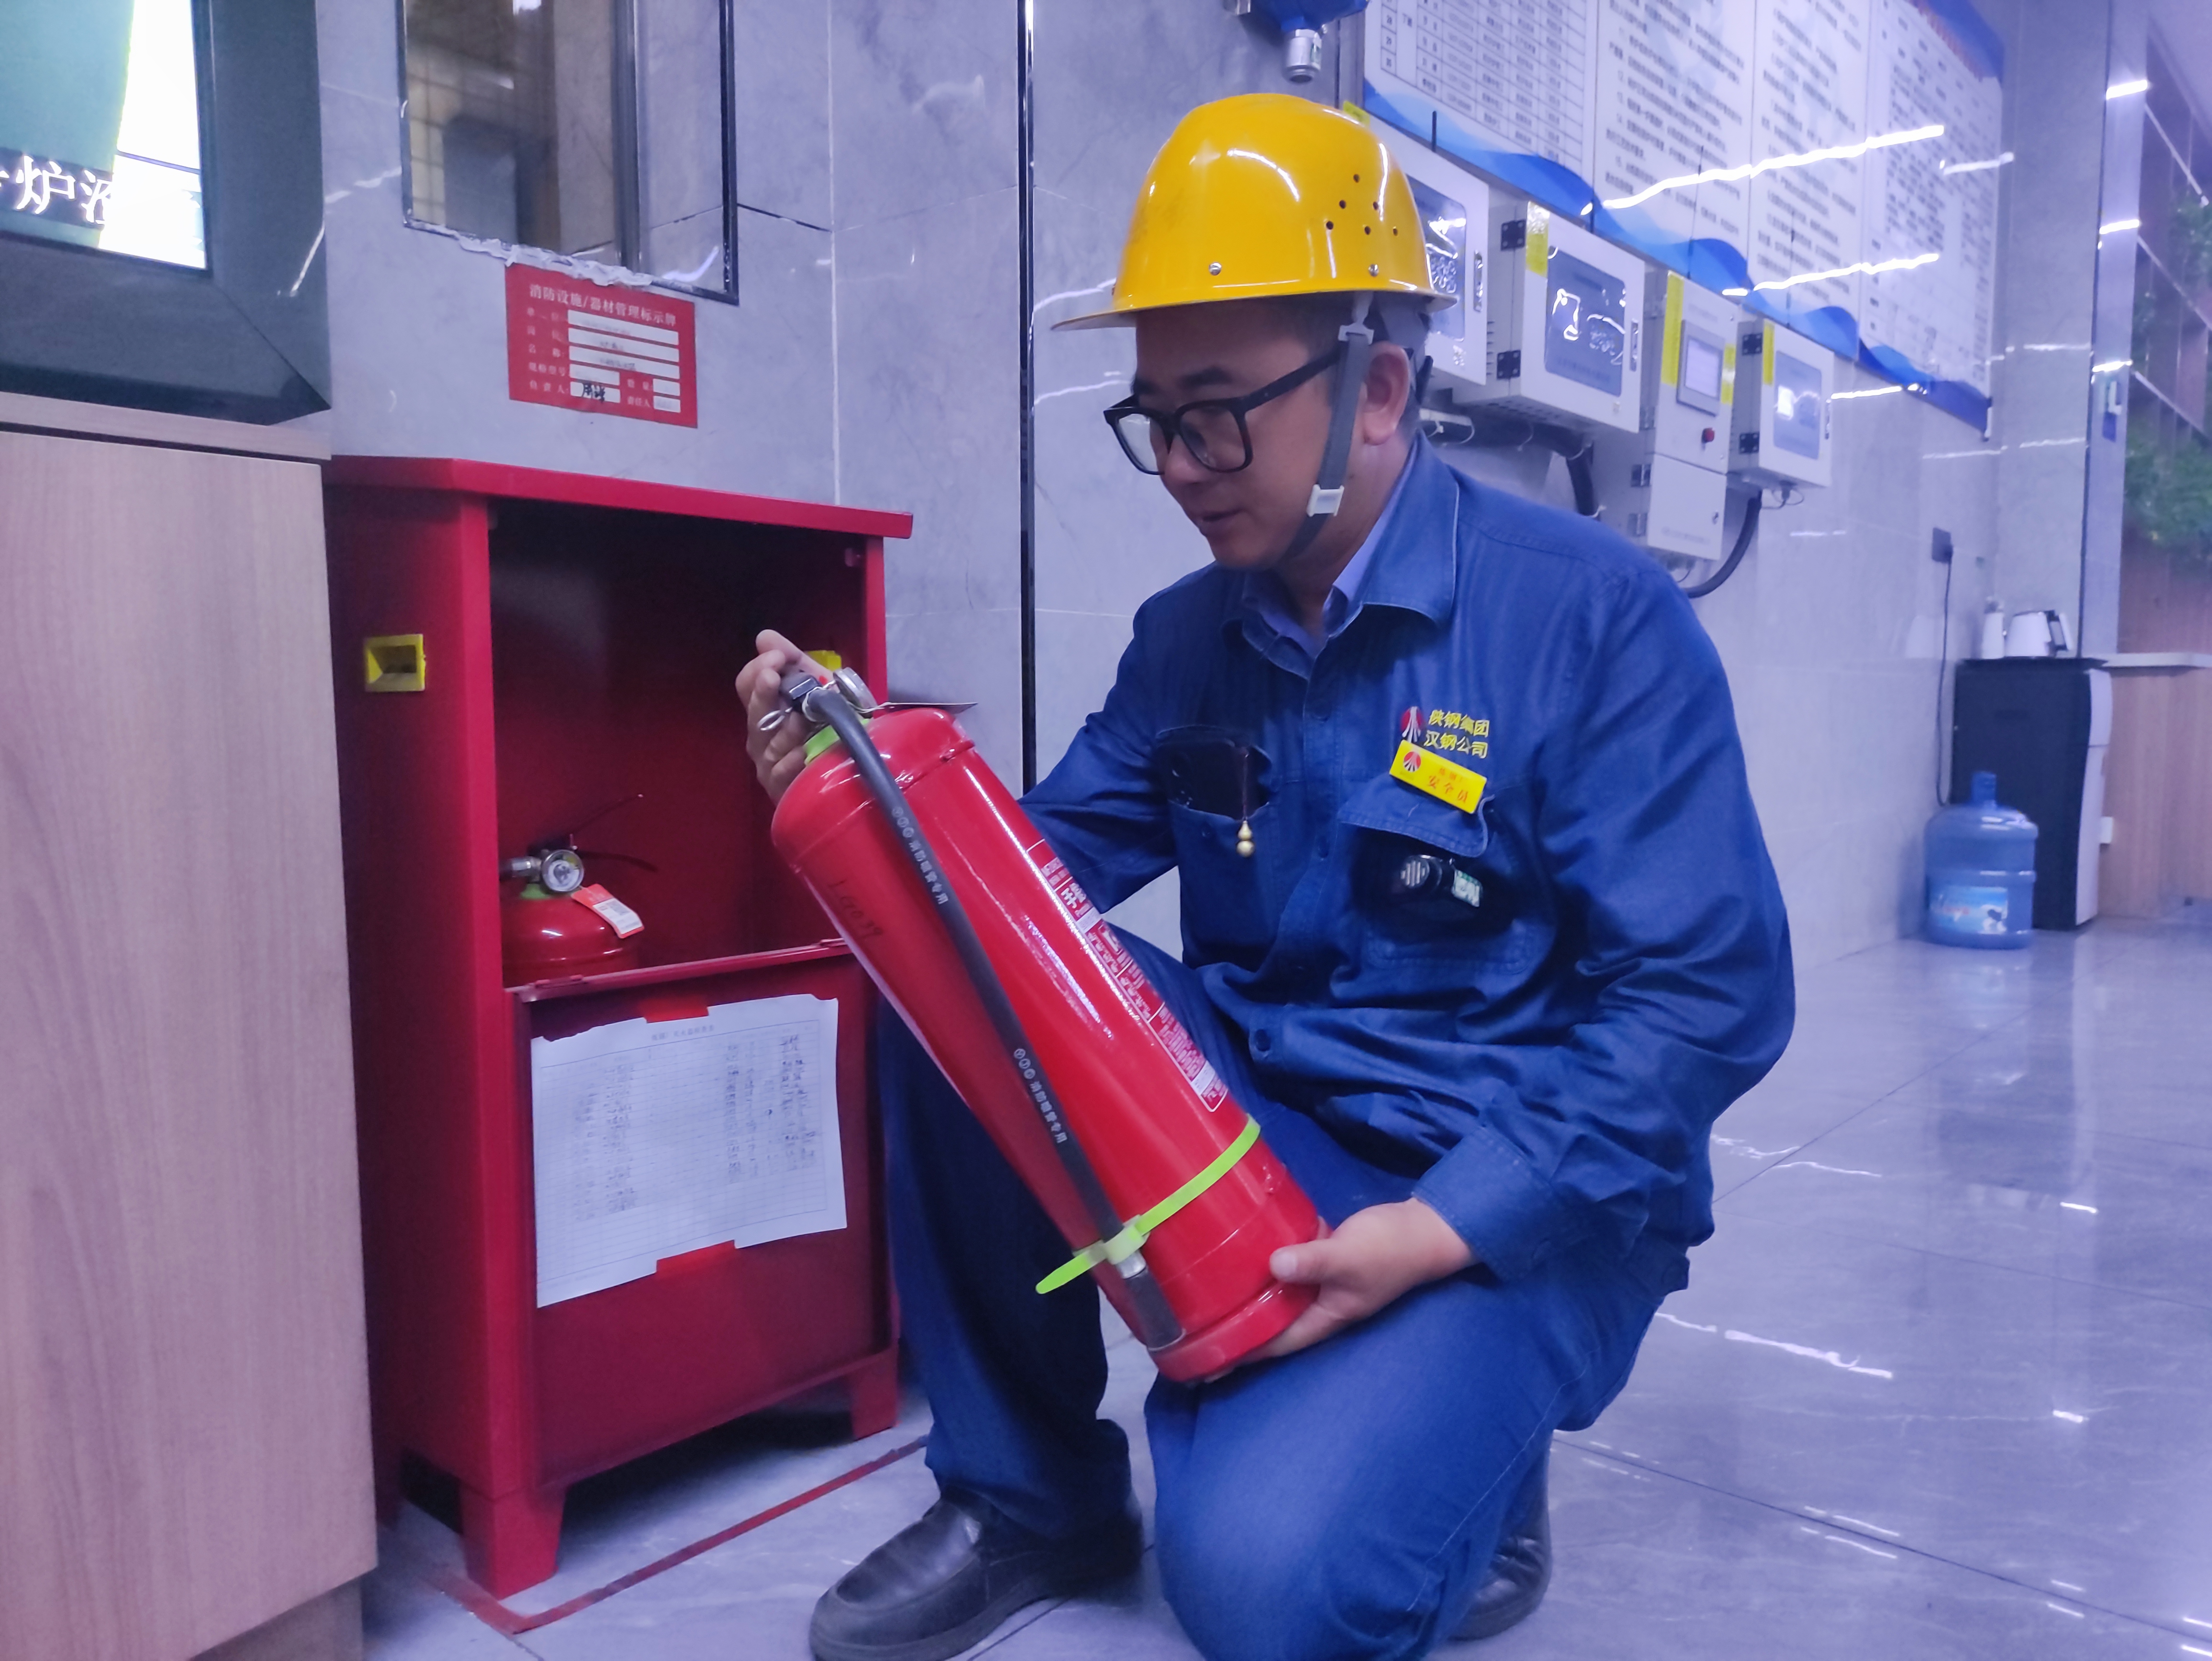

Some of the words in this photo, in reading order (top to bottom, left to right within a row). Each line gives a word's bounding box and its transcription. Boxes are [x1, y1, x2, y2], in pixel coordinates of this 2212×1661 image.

[530, 284, 676, 327] 消防设施/器材管理标示牌
[1424, 730, 1488, 759] 汉钢公司
